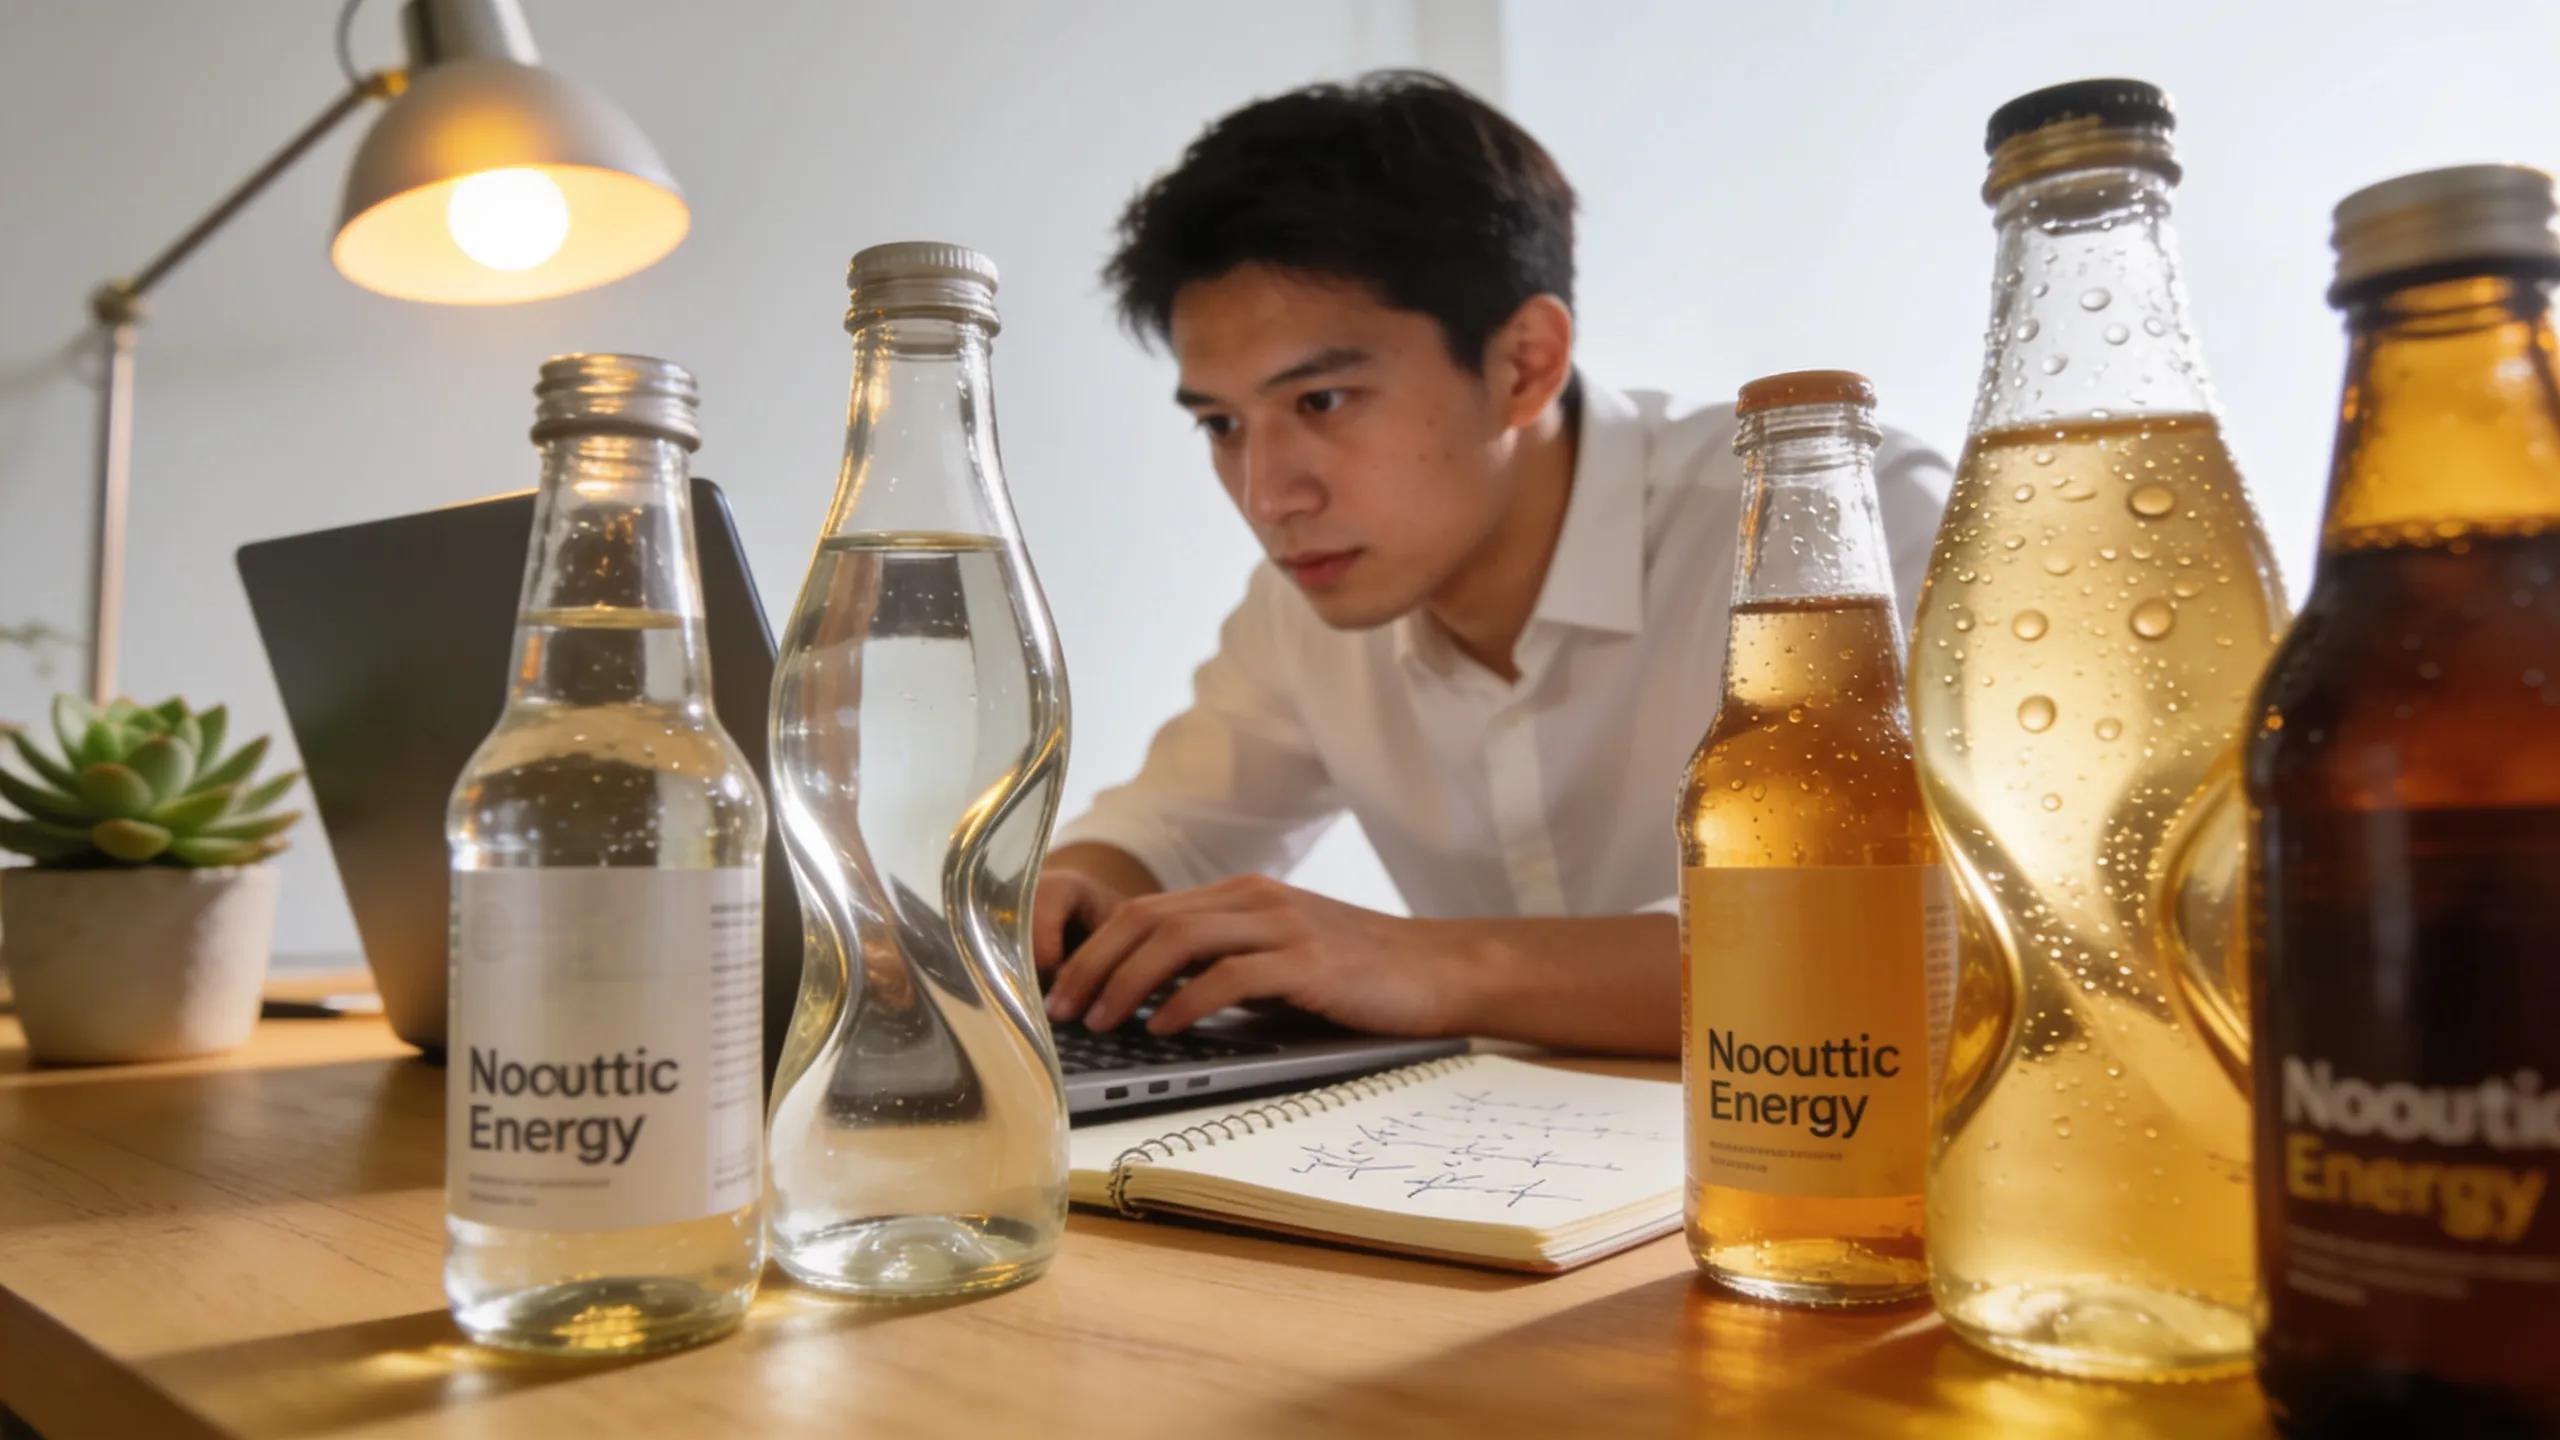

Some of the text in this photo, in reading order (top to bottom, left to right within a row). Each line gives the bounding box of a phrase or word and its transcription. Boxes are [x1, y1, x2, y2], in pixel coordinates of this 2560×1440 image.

[1709, 1028, 1900, 1078] Noouttic
[470, 1105, 646, 1165] Energy
[1711, 1080, 1869, 1139] Energy
[2287, 1132, 2545, 1239] Energy
